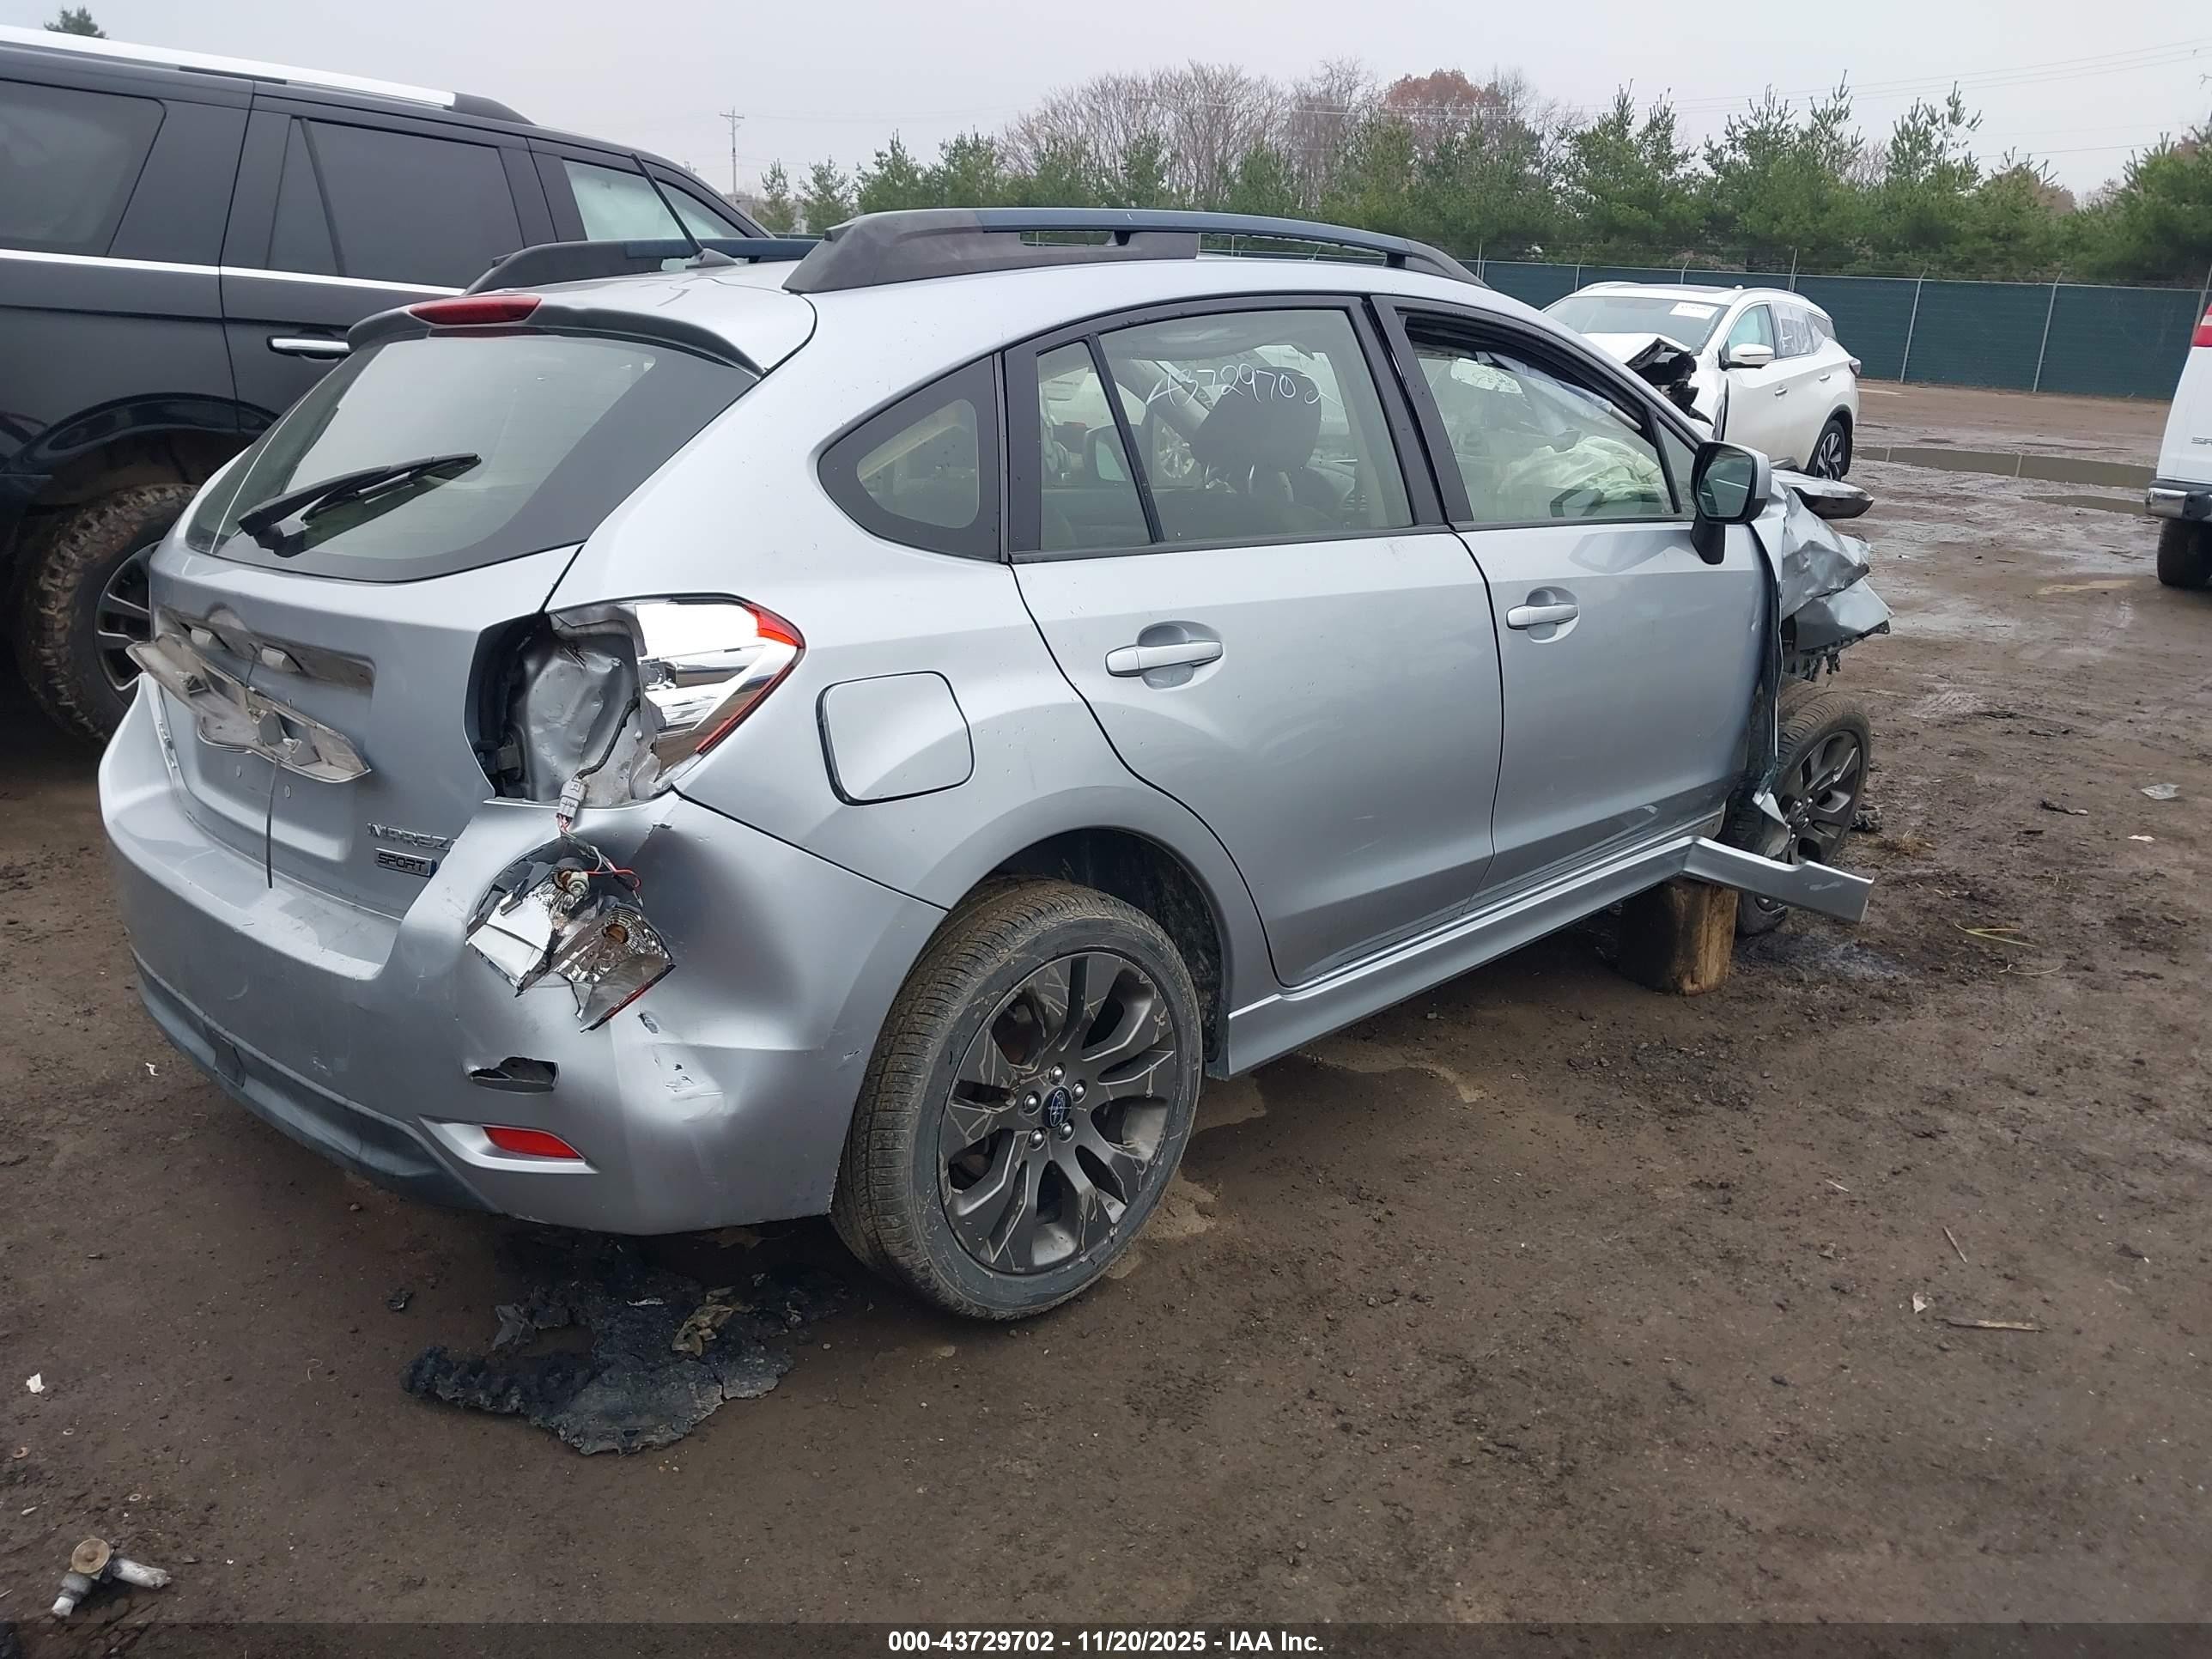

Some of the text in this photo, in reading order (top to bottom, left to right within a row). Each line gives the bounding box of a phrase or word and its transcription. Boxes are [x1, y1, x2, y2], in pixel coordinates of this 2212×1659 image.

[1146, 363, 1340, 406] 43729702
[367, 822, 457, 850] IMPREZ
[378, 853, 426, 871] SPORT
